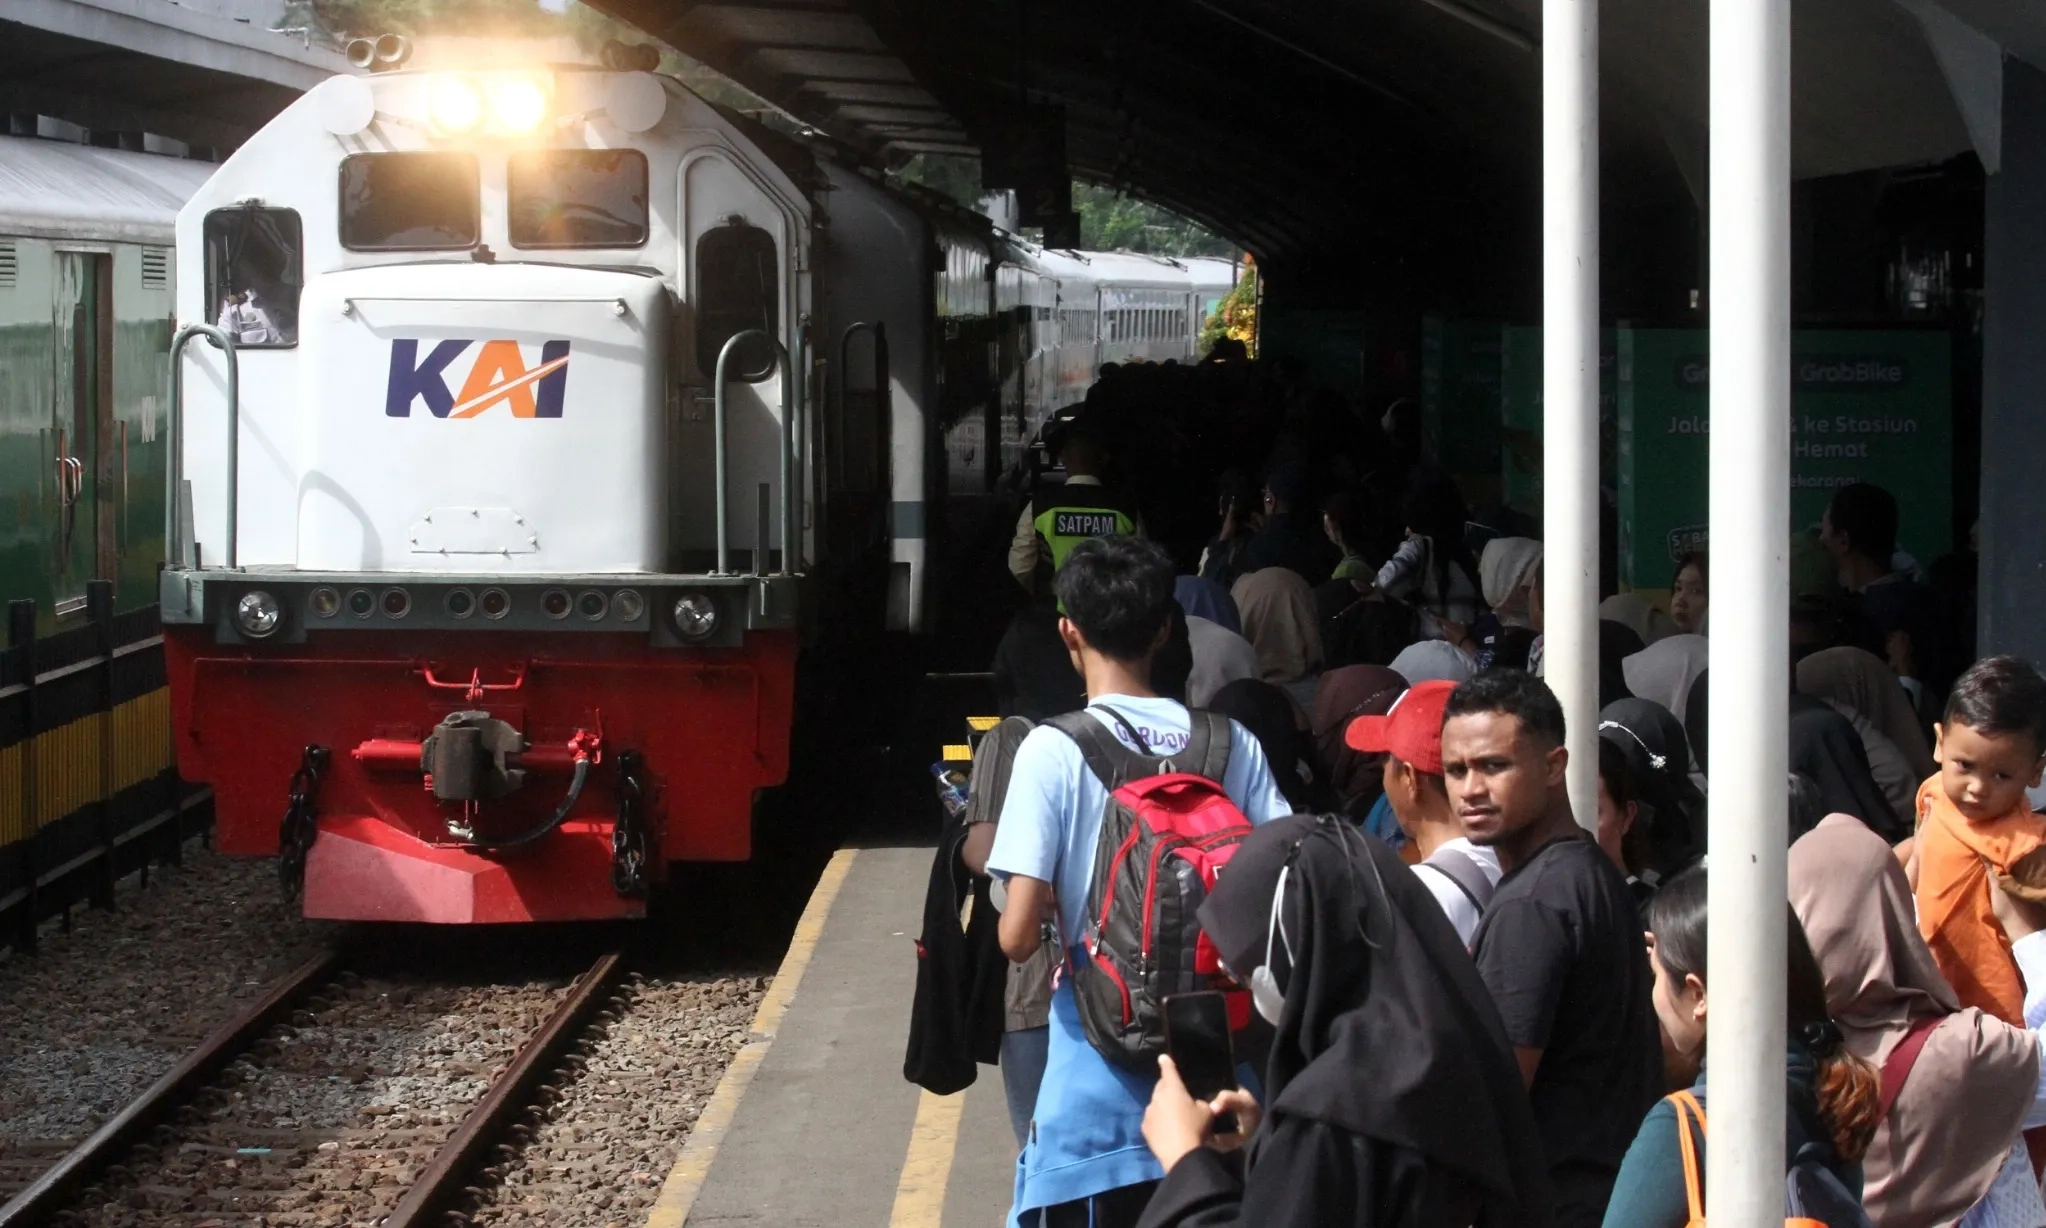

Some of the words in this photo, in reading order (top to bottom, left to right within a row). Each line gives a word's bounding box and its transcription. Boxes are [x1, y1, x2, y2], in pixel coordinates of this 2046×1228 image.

[386, 339, 570, 418] KAI
[1800, 362, 1902, 382] GrabBike
[1668, 415, 1709, 434] Jala
[1805, 415, 1830, 434] ke
[1836, 415, 1918, 434] Stasiun
[1795, 440, 1869, 458] Hemat
[1058, 514, 1114, 533] SATPAM
[1113, 721, 1191, 750] GRDON
